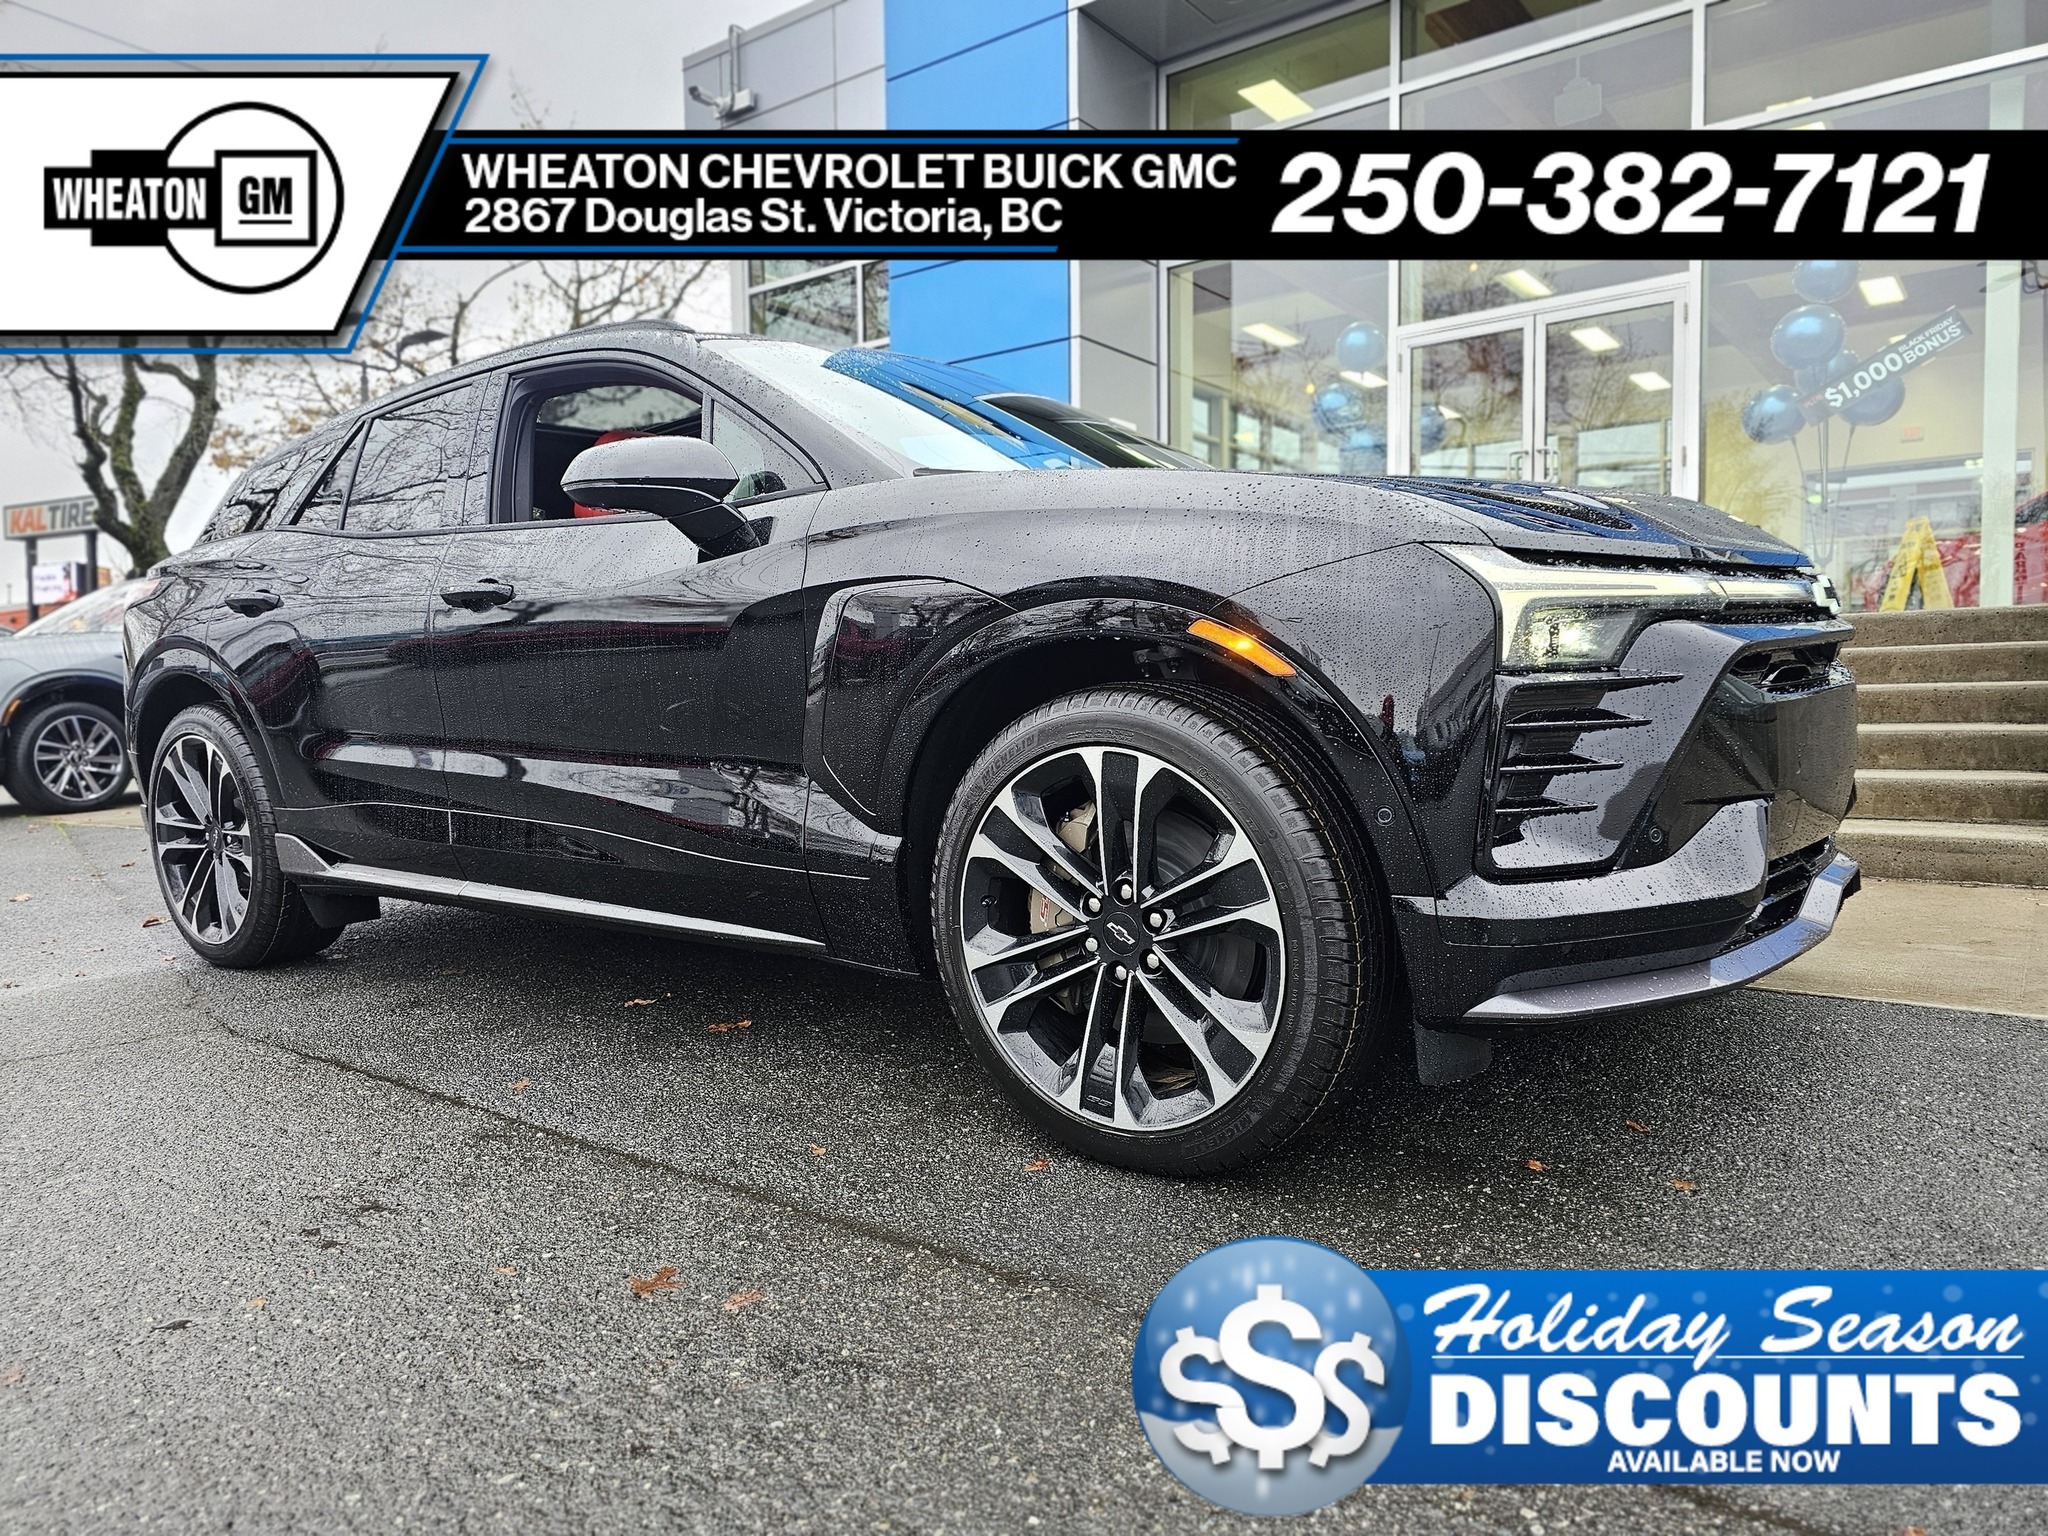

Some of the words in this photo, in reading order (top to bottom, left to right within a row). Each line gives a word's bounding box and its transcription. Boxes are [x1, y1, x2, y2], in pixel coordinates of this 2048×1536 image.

[1898, 333, 1926, 353] BLACK
[1925, 316, 1954, 339] FRIDAY
[1824, 352, 1903, 408] $1,000
[1902, 324, 1962, 365] BONUS
[10, 507, 47, 534] KAL
[48, 501, 95, 530] TIRE
